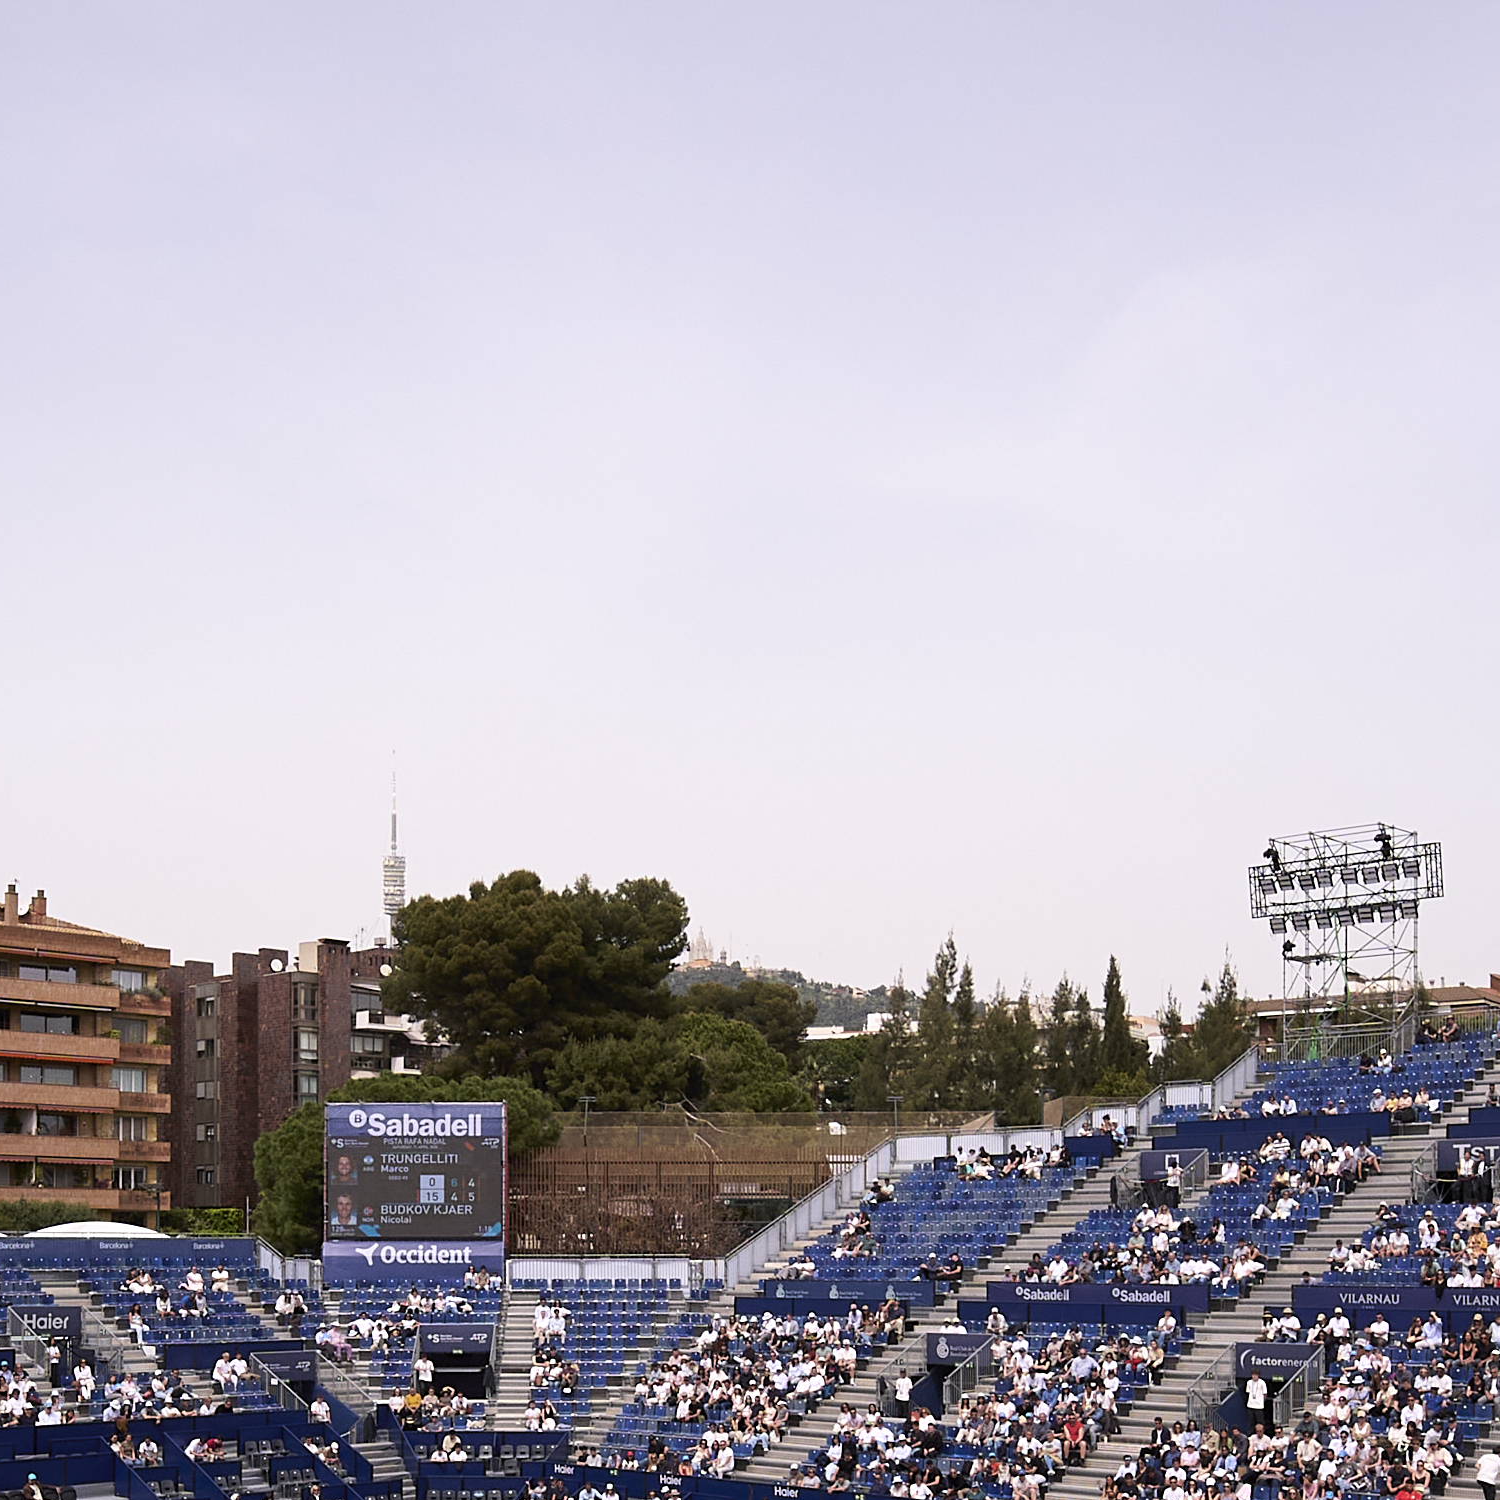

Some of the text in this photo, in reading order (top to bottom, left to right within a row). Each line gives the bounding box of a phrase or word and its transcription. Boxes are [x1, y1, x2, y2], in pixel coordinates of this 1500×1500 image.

[367, 1113, 482, 1137] Sabadell
[1453, 1144, 1500, 1162] TST
[381, 1154, 458, 1164] TRUNGELLITI
[381, 1165, 409, 1173] Marco
[429, 1178, 436, 1187] 0
[451, 1178, 458, 1187] 6
[468, 1178, 476, 1187] 4
[426, 1192, 439, 1201] 15
[451, 1193, 458, 1201] 4
[468, 1193, 476, 1201] 5
[381, 1205, 473, 1215] BUDKOV KJAER
[381, 1215, 412, 1224] Nicolai
[99, 1242, 130, 1251] Barcelona
[193, 1243, 220, 1251] Barcelona
[380, 1244, 472, 1264] Occident
[1023, 1288, 1071, 1301] Sabadell
[1120, 1289, 1171, 1303] Sabadell
[1339, 1294, 1400, 1305] VILARNAU
[24, 1313, 69, 1330] Haier
